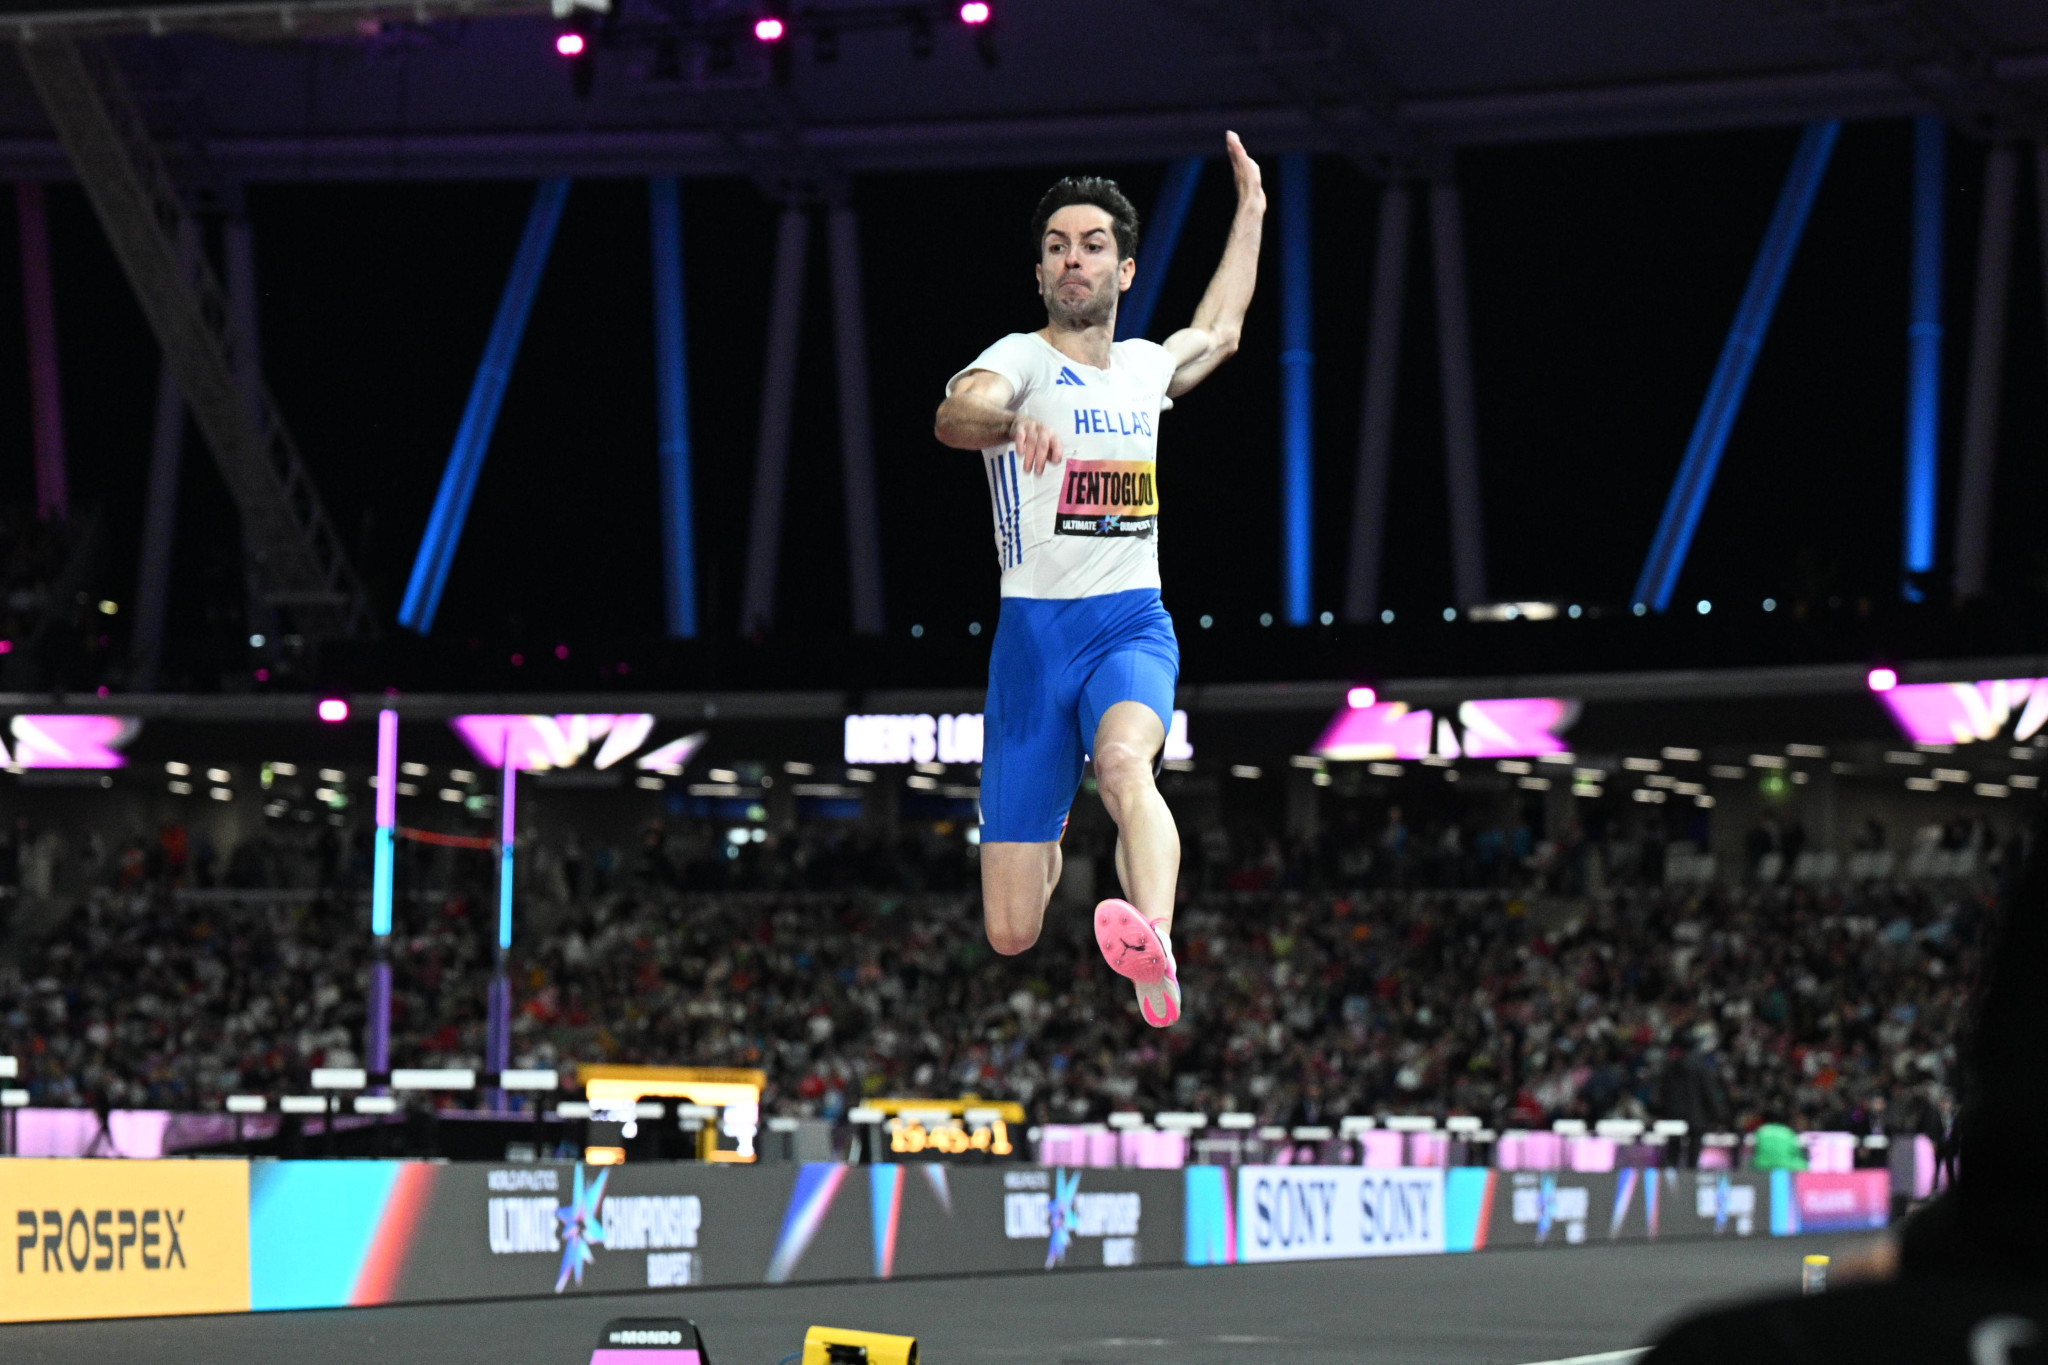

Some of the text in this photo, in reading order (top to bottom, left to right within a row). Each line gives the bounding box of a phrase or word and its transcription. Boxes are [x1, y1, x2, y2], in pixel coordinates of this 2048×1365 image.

[1074, 409, 1151, 437] HELLAS
[1066, 471, 1153, 505] TENTOGLOU
[1063, 520, 1096, 531] ULTIMATE
[1255, 1178, 1338, 1249] SONY
[1359, 1178, 1434, 1244] SONY
[16, 1207, 188, 1274] PROSPEX
[620, 1330, 682, 1345] MONDO
